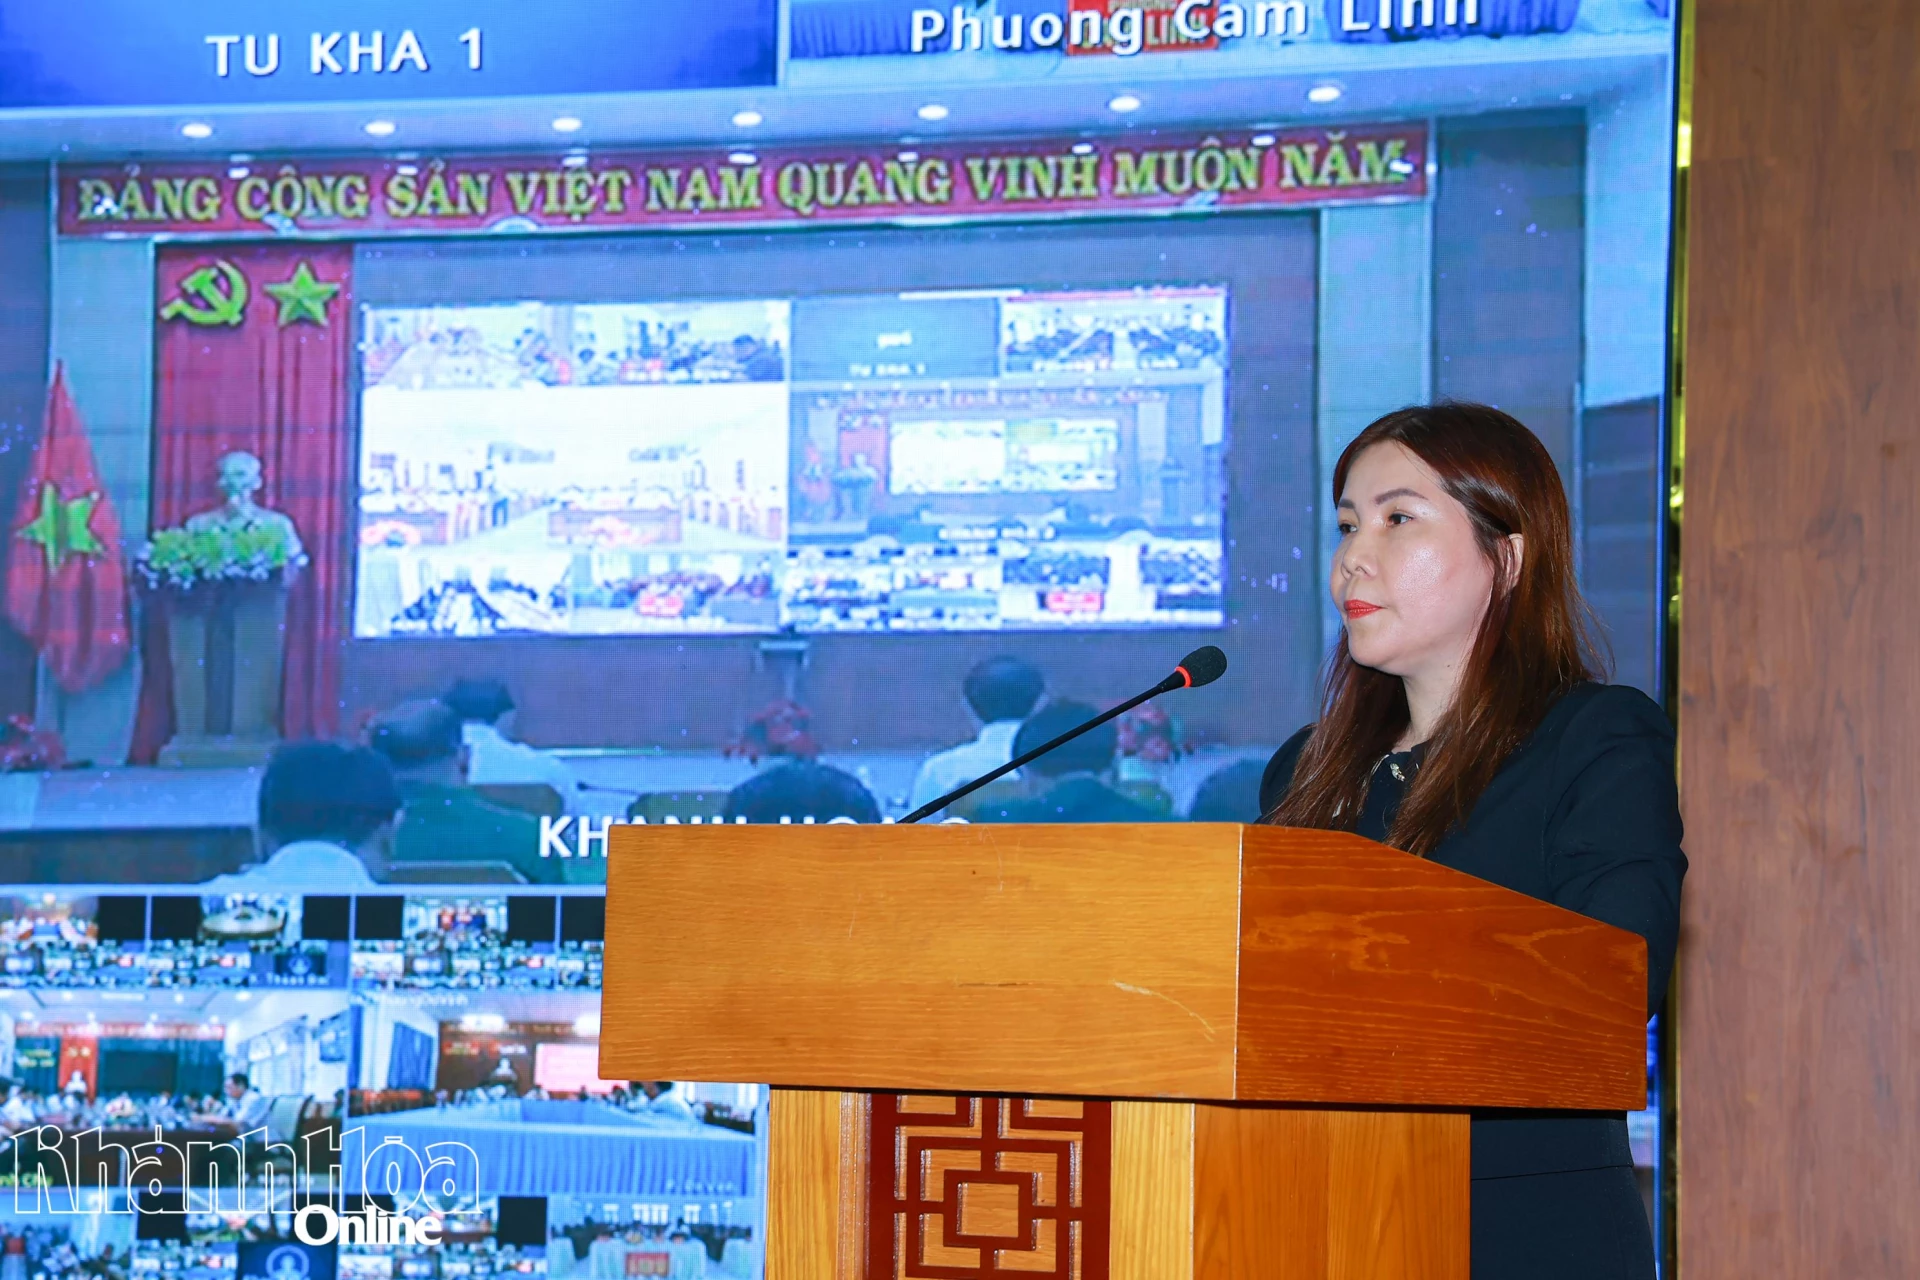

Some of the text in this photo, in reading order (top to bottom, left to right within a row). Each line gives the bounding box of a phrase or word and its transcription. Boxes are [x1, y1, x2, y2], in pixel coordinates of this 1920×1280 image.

[204, 27, 482, 77] TU KHA 1
[911, 5, 1142, 56] Phuong
[1174, 0, 1307, 38] Cam
[236, 164, 370, 219] CÔNG
[385, 157, 491, 218] SẢN
[645, 163, 763, 212] NAM
[777, 158, 951, 216] QUANG
[966, 154, 1099, 202] VINH
[1113, 136, 1262, 195] MUÔN
[1279, 130, 1407, 188] NĂM
